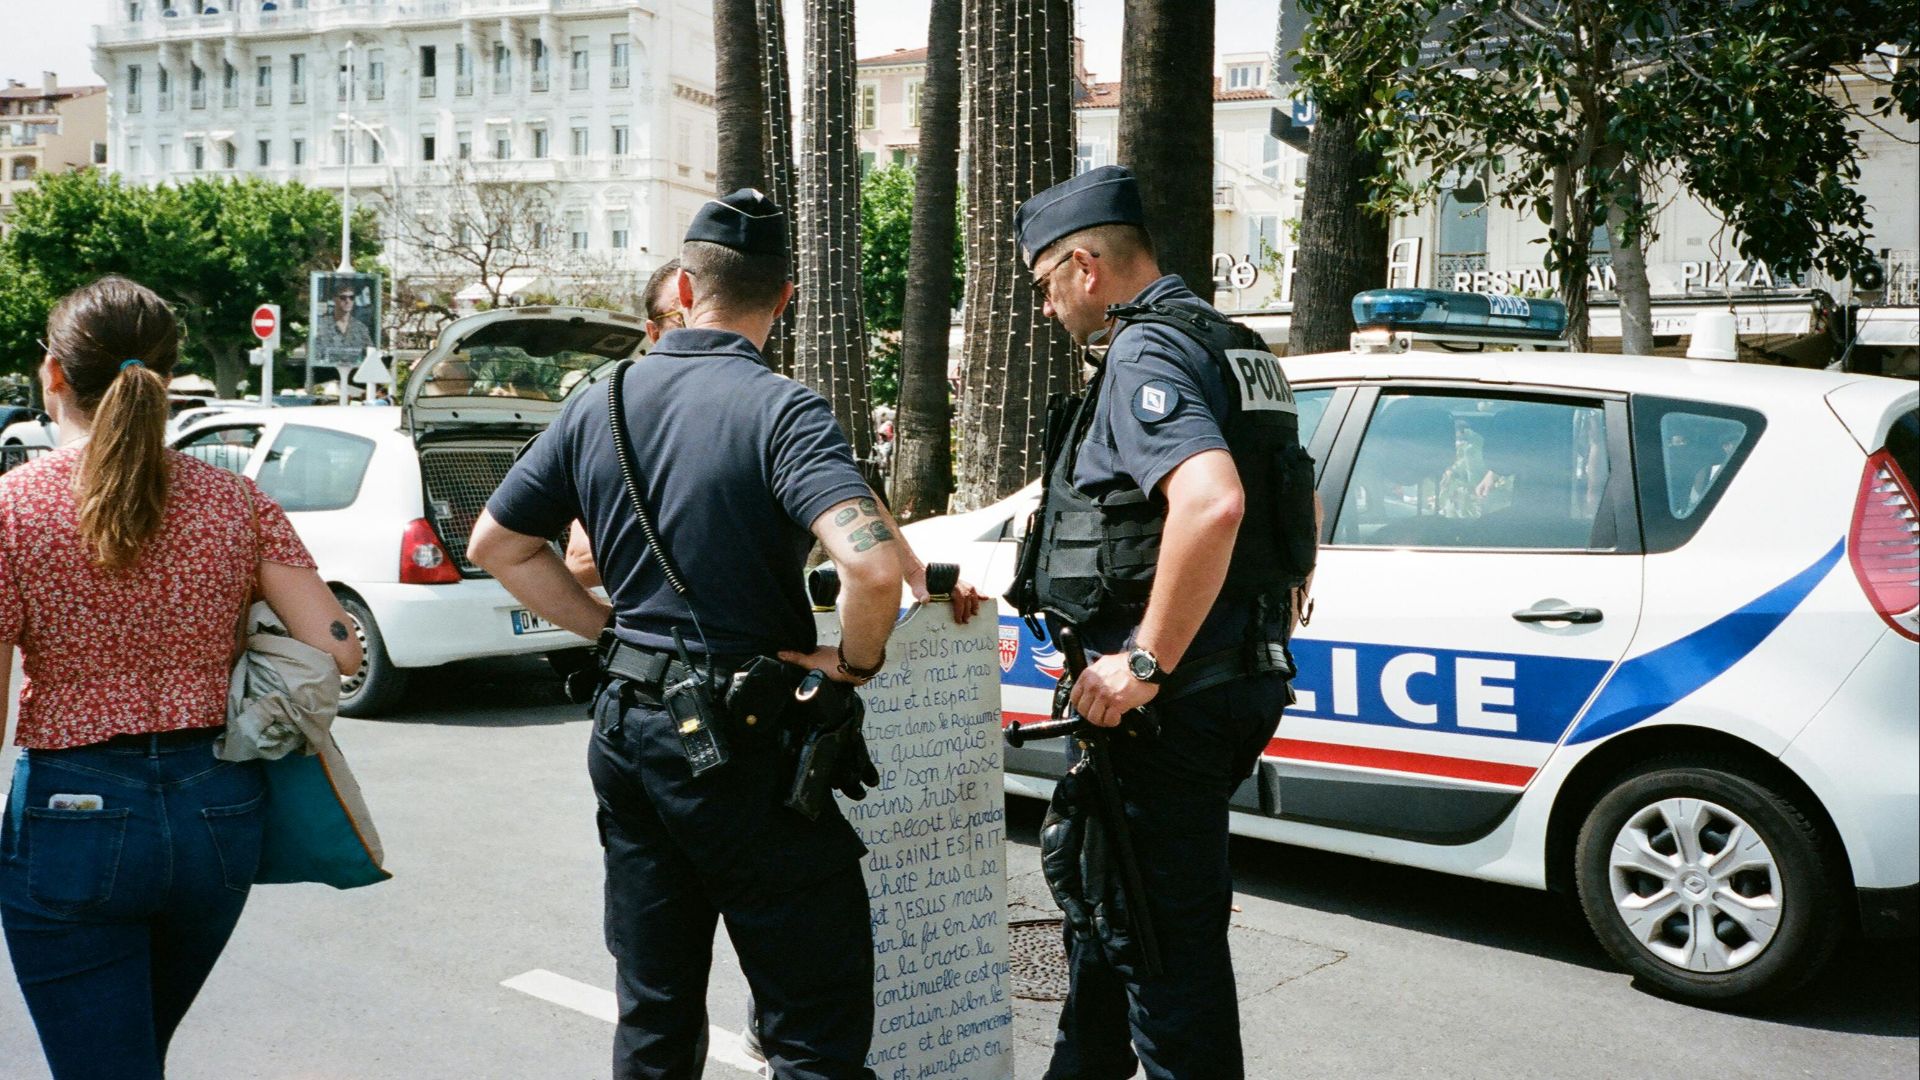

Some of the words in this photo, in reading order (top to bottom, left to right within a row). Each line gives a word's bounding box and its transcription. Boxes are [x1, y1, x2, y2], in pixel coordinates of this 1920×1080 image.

[1454, 264, 1617, 296] RESTAUAN
[1681, 259, 1774, 289] PIZZA
[1490, 294, 1529, 316] POLICE
[952, 636, 994, 654] nous
[904, 688, 919, 710] et
[1293, 647, 1518, 733] ICE
[905, 716, 936, 735] dans
[903, 767, 940, 787] son
[848, 793, 913, 821] moins
[869, 850, 892, 872] du
[869, 872, 918, 899] chete
[925, 867, 961, 888] tous
[895, 894, 946, 929] JESUS
[952, 885, 993, 907] nous
[873, 935, 898, 954] ar
[898, 930, 917, 949] la
[968, 910, 998, 931] son
[897, 954, 918, 978] la
[975, 936, 994, 956] la
[875, 968, 961, 1007] continuelle
[950, 991, 988, 1017] selon
[990, 983, 1005, 1004] le
[864, 1042, 907, 1067] ance
[919, 1031, 935, 1052] et
[937, 1026, 954, 1047] de
